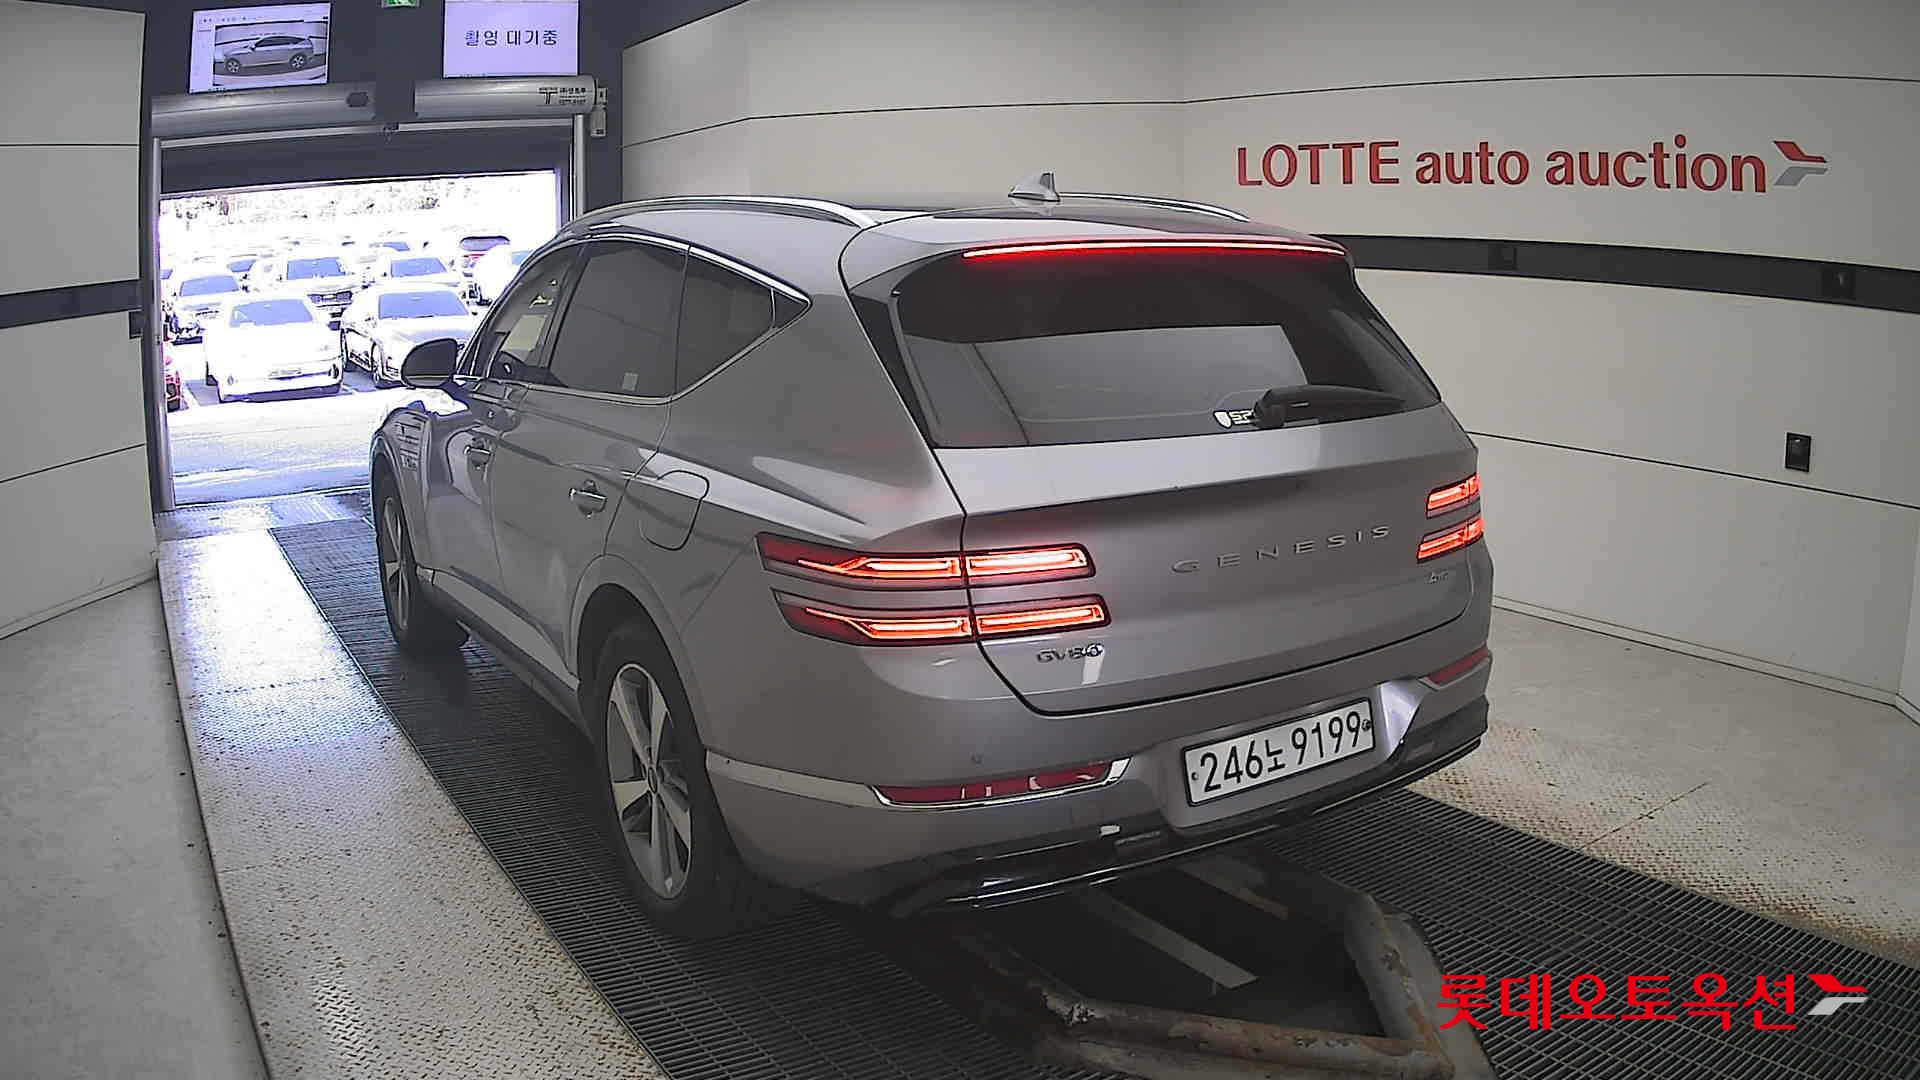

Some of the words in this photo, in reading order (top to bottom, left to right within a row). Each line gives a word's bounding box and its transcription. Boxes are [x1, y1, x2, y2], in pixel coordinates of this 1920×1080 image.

[506, 29, 558, 46] 대기중
[1237, 140, 1400, 188] LOTTE
[1415, 141, 1529, 187] auto
[1545, 135, 1767, 194] auction
[1171, 525, 1391, 574] GENESIS
[1199, 739, 1286, 793] 246노
[1291, 711, 1361, 766] 9199
